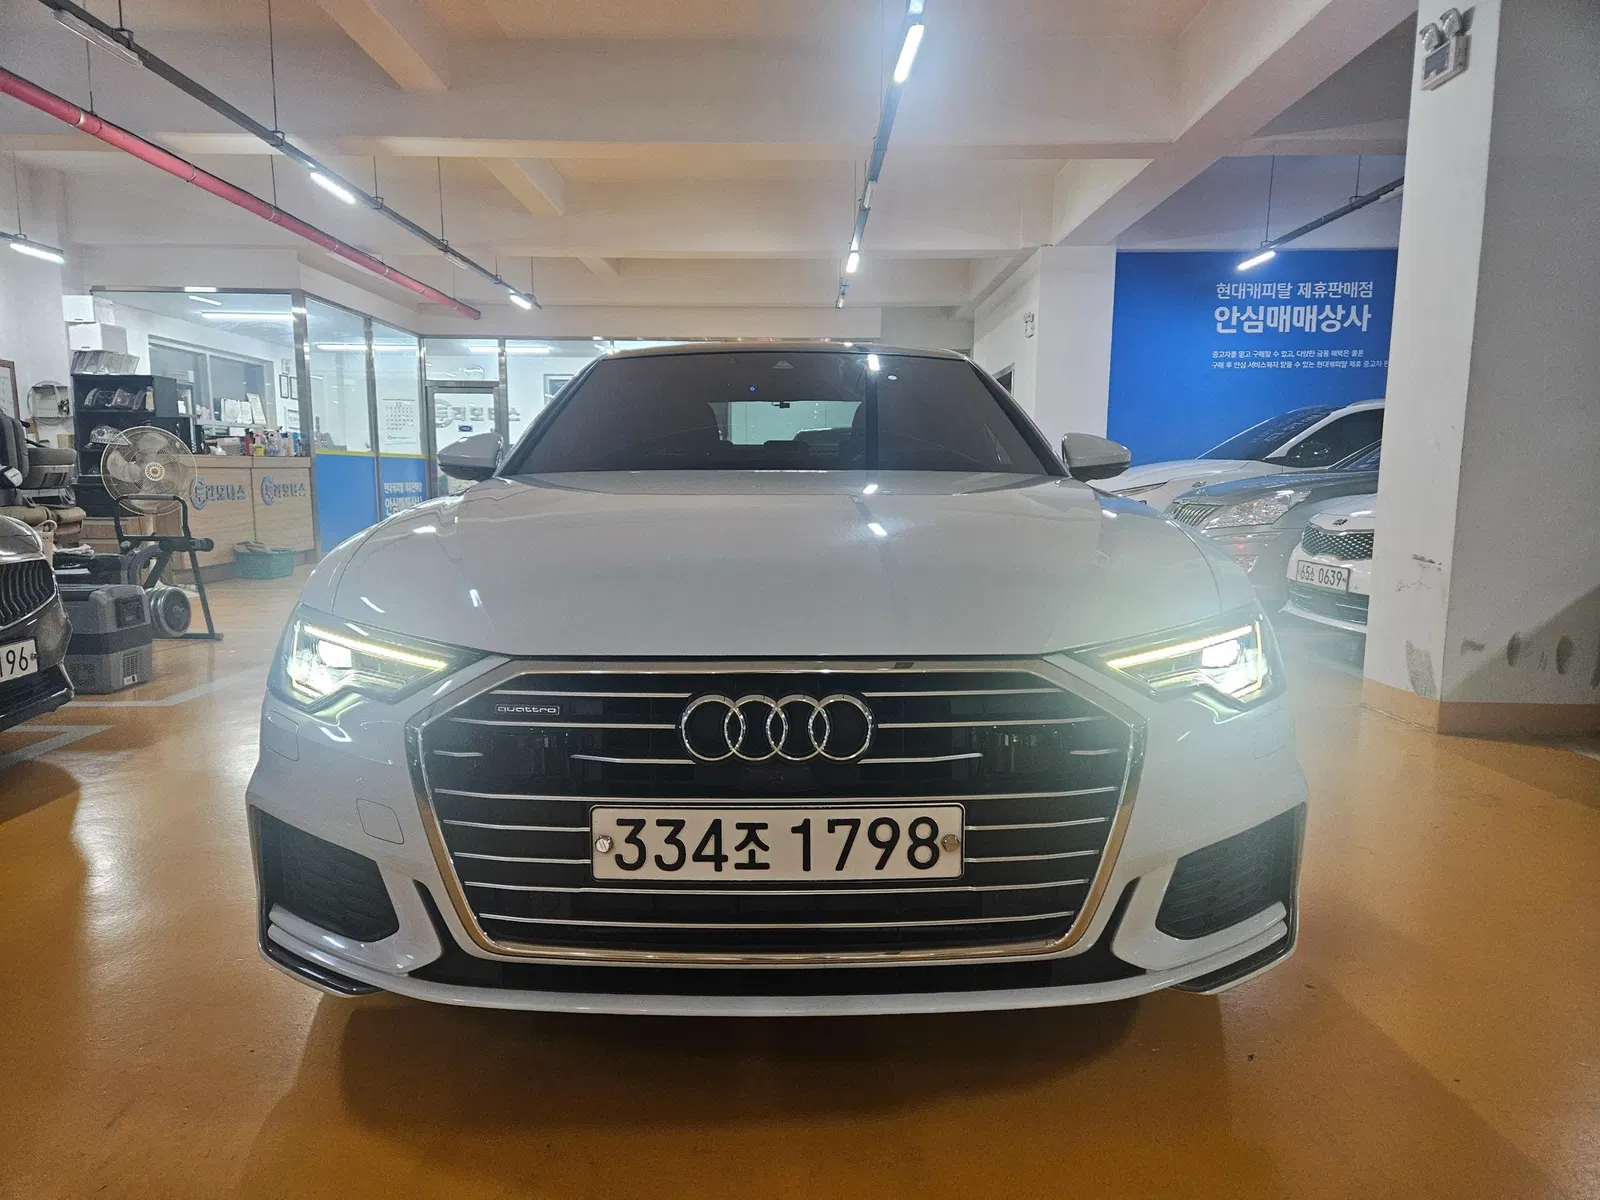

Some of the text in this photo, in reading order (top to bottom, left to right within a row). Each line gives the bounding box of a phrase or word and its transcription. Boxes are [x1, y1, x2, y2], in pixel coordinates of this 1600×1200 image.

[1216, 281, 1373, 299] 현대캐피탈 제휴판매점
[1214, 304, 1372, 334] 안심매매상사
[1212, 350, 1237, 358] 중고차를
[1273, 350, 1280, 358] 수
[1296, 349, 1315, 358] 다양한
[1234, 361, 1246, 369] 안심
[1294, 361, 1301, 369] 수
[1318, 568, 1343, 586] 0639
[497, 705, 557, 714] quattro
[614, 816, 941, 872] 334조 1798
